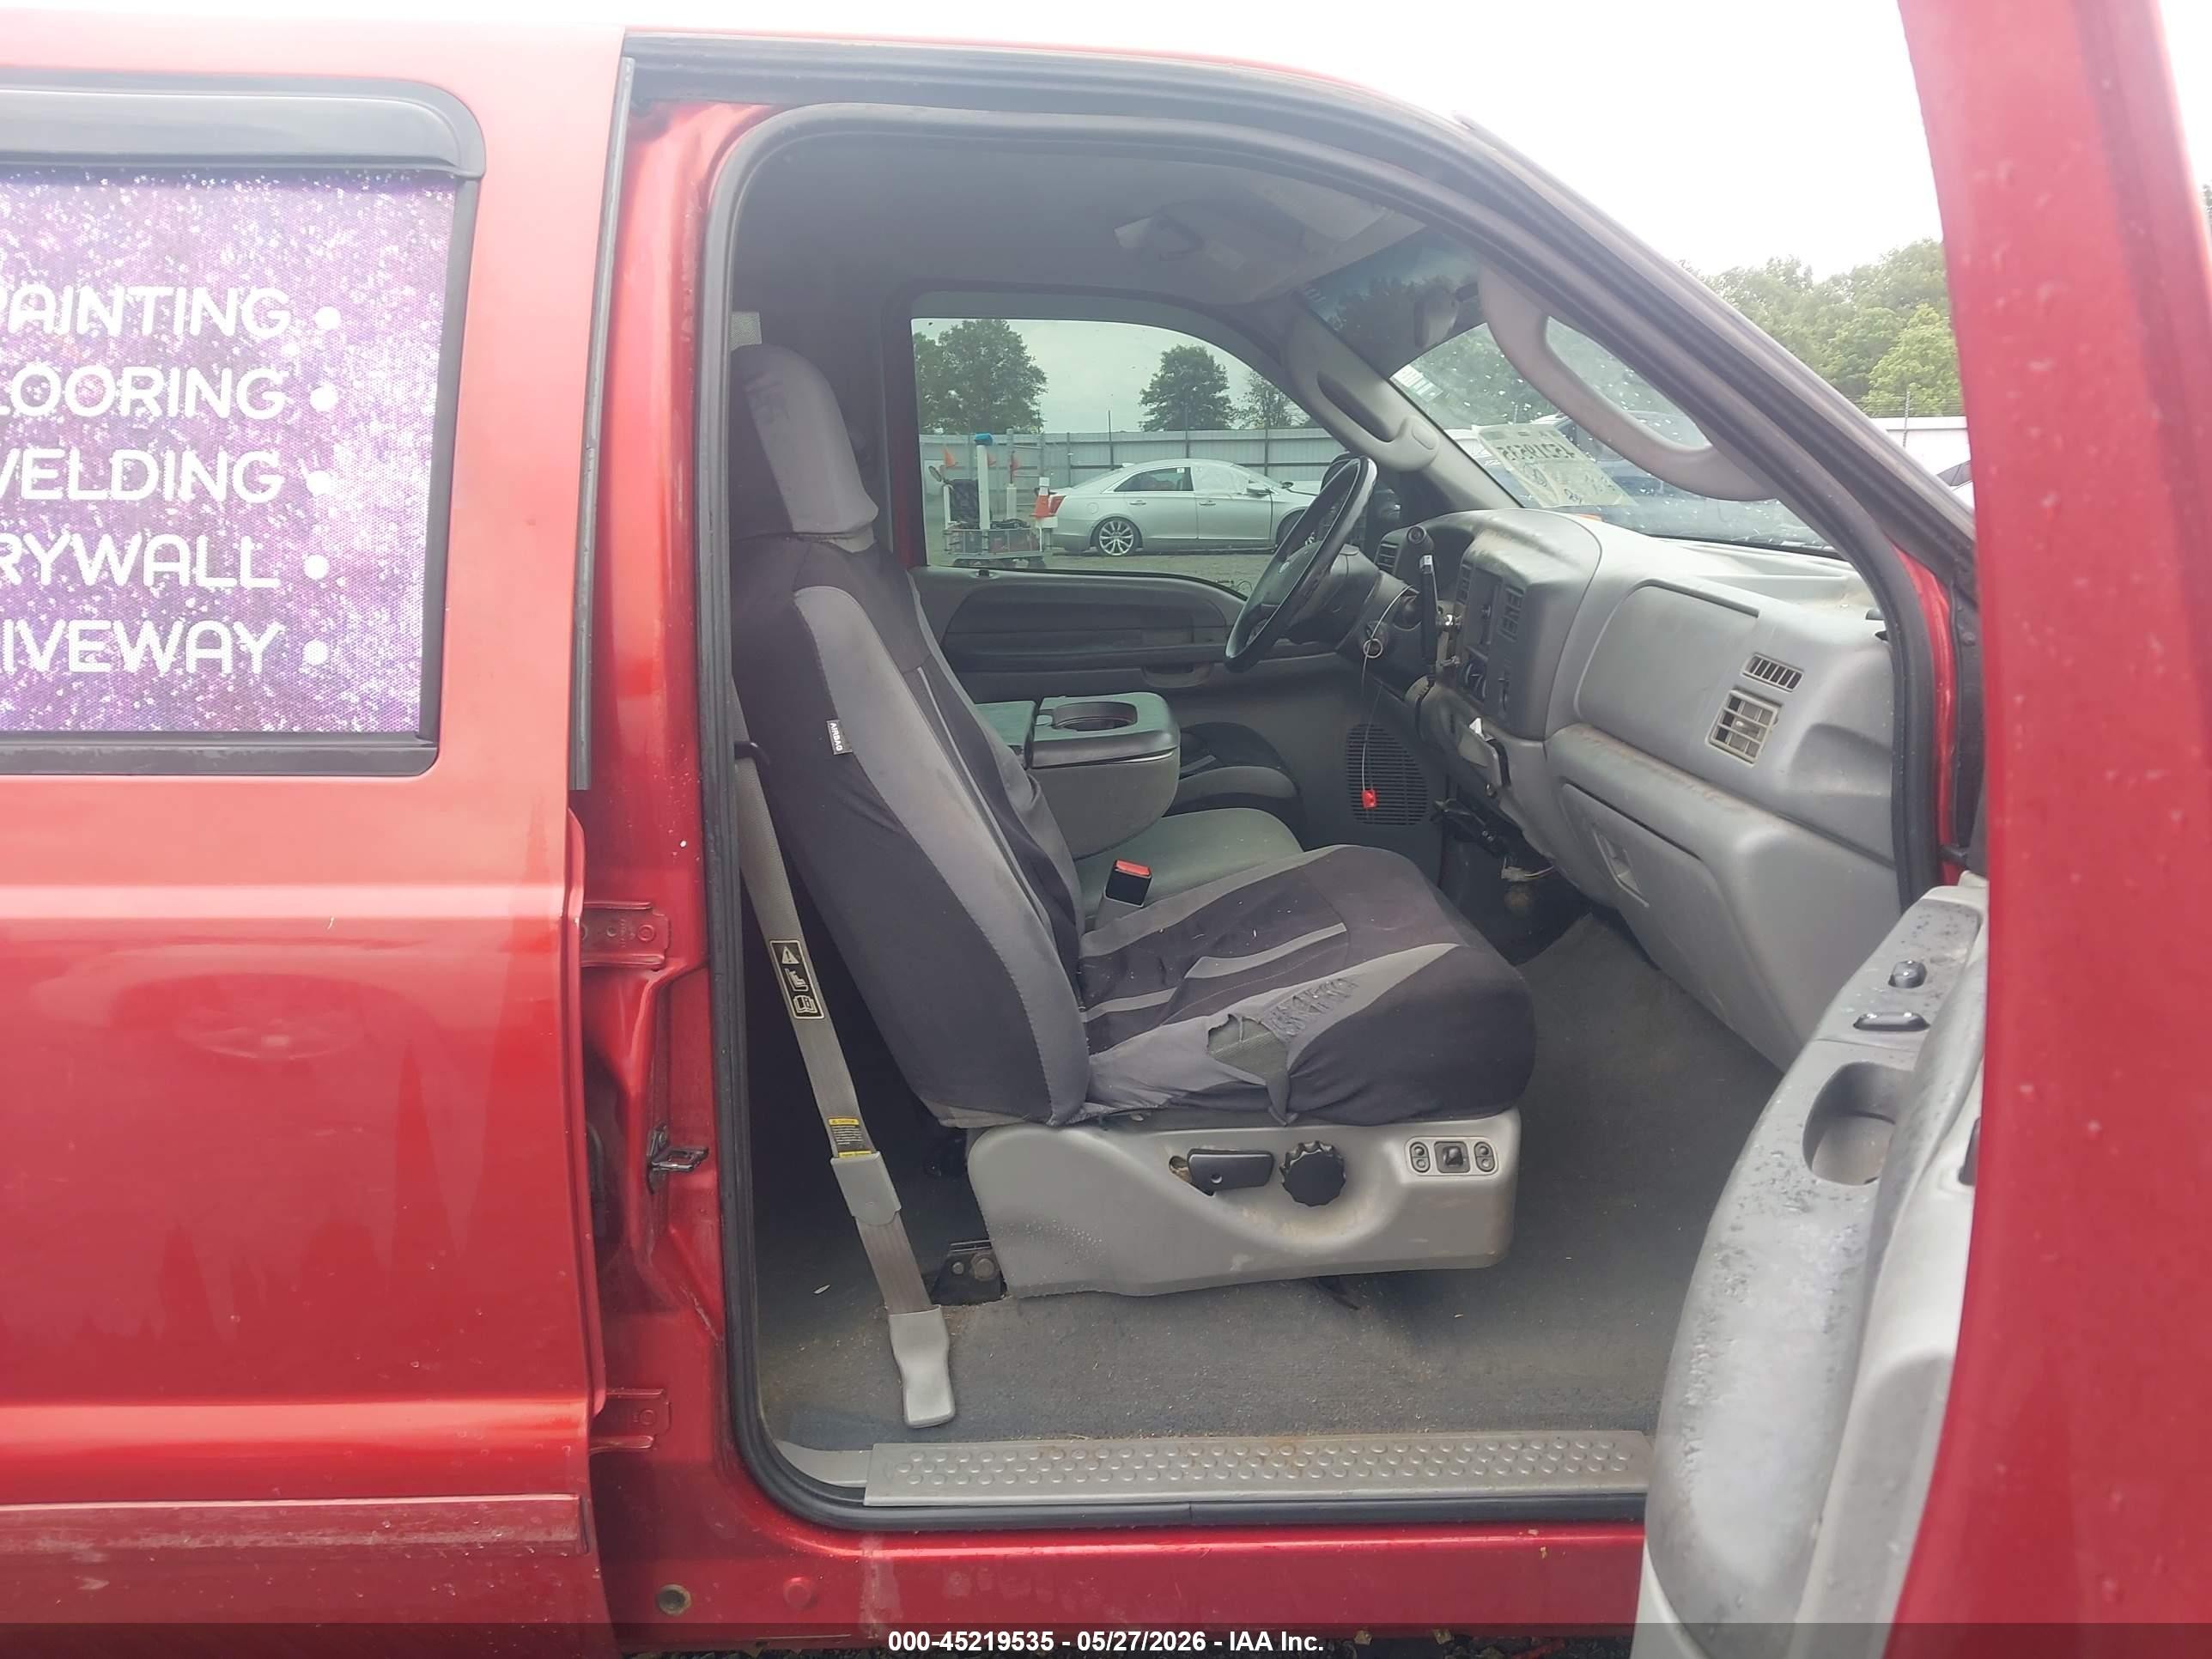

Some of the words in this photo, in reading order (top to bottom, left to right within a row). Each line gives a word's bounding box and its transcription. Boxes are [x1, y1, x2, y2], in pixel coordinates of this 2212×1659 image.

[0, 284, 290, 337] AINTING
[0, 364, 288, 418] OORING
[830, 722, 843, 751] AIRBAG
